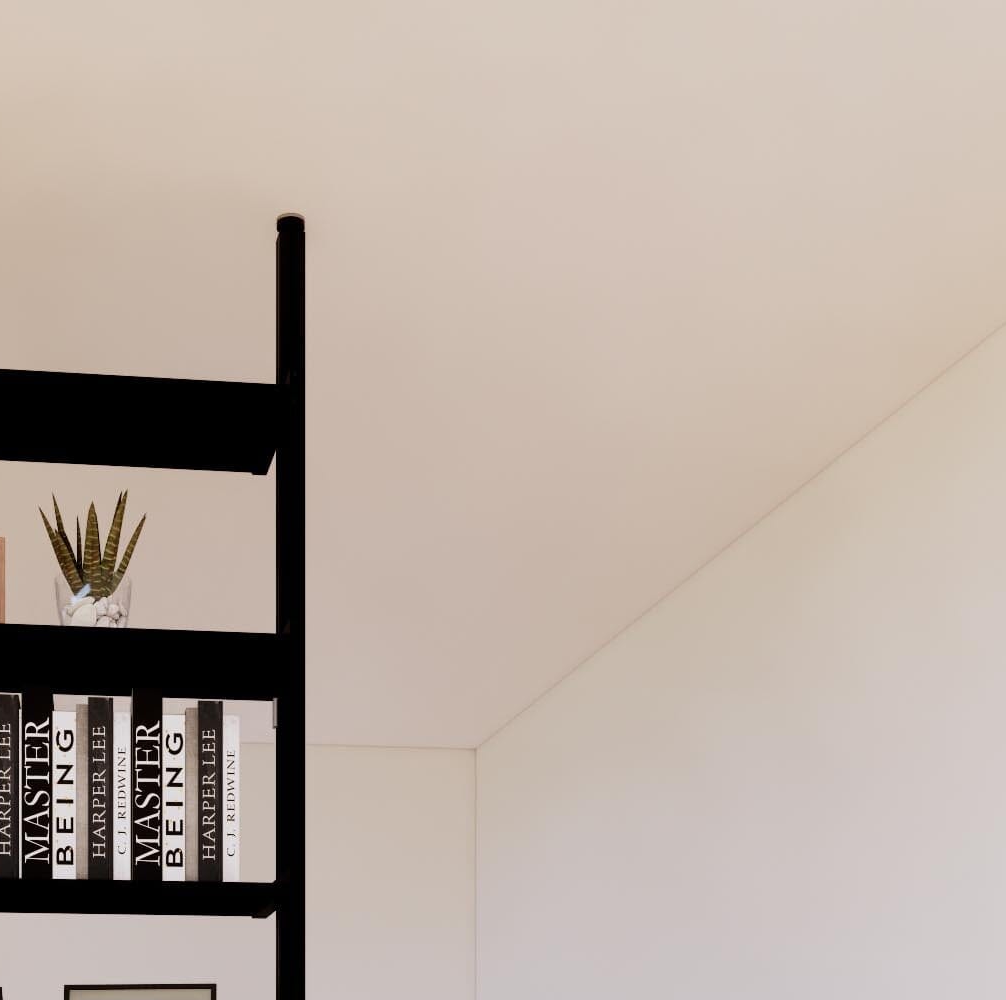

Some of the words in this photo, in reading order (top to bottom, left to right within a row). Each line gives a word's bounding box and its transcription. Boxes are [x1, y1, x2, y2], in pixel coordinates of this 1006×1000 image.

[93, 726, 106, 763] LEE
[118, 747, 126, 820] REDWINE
[202, 730, 215, 766] LEE
[226, 750, 235, 822] REDWINE
[23, 717, 50, 864] MASTER
[56, 730, 74, 865] BEING
[93, 769, 106, 858] HARPER
[134, 720, 160, 866] MASTER
[166, 733, 183, 867] BEING
[202, 772, 215, 860] HARPER
